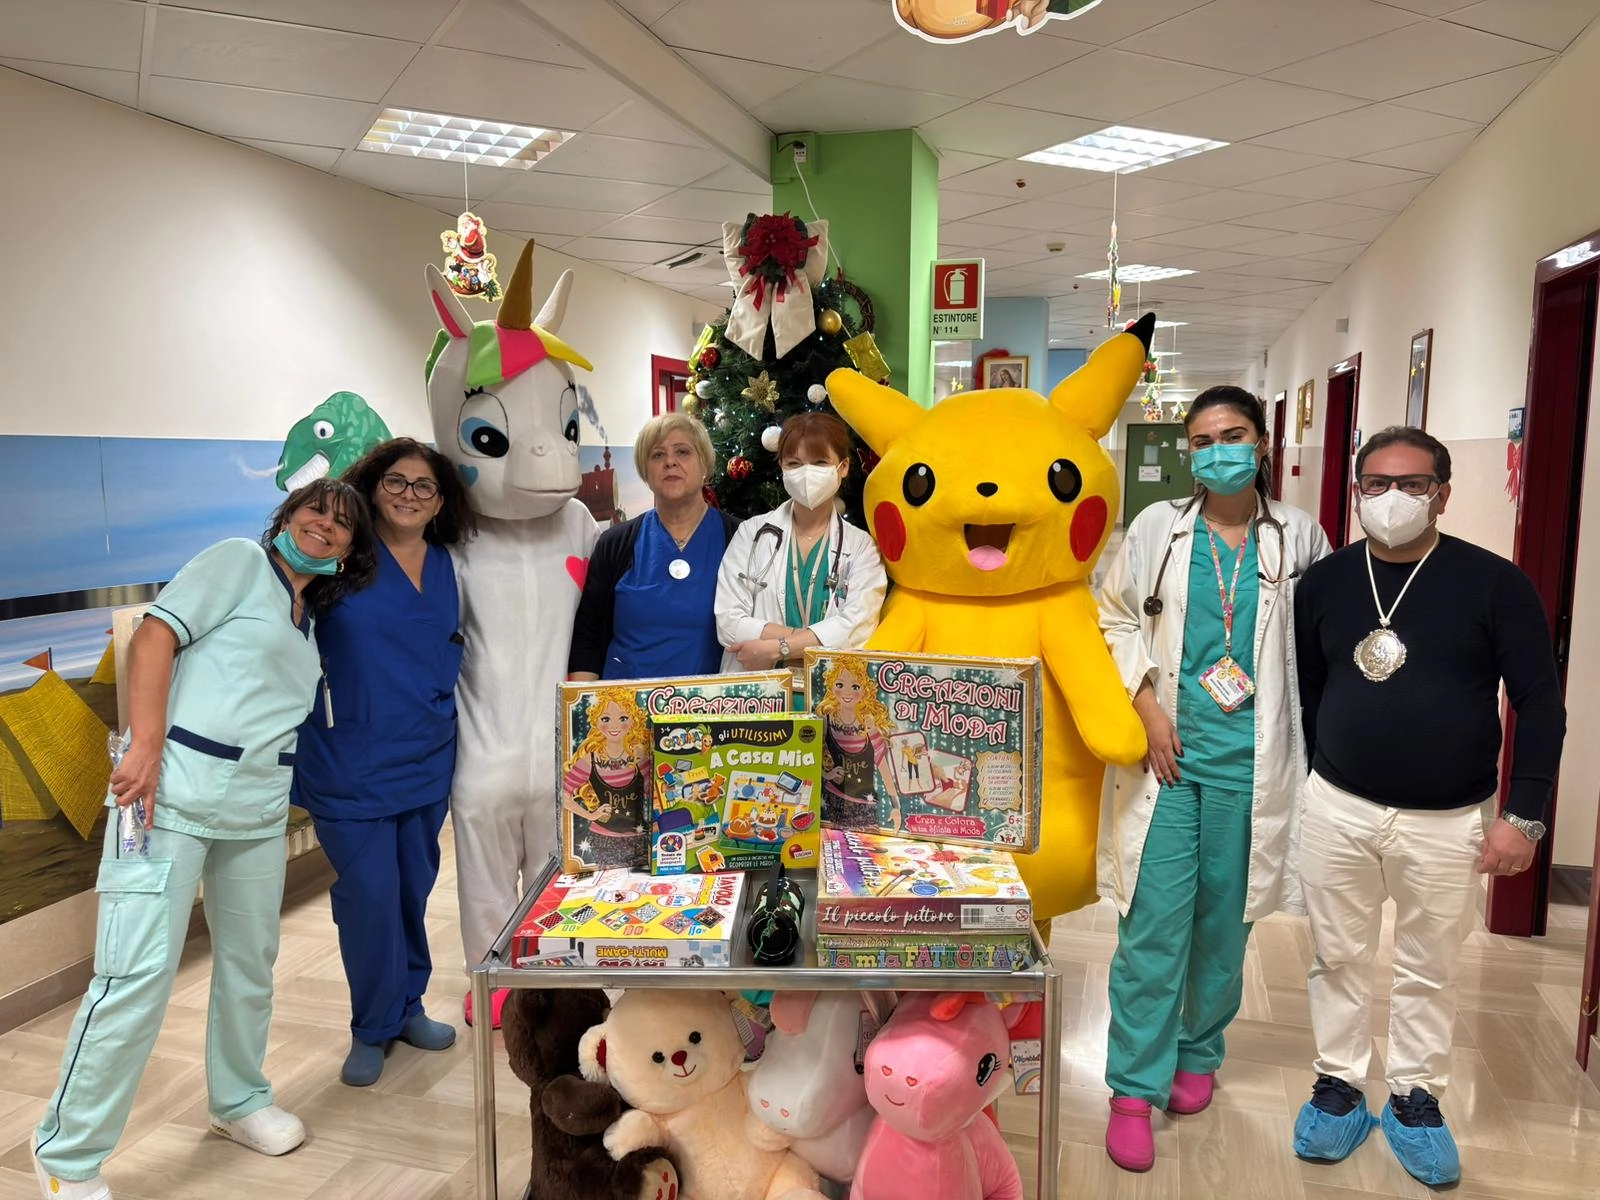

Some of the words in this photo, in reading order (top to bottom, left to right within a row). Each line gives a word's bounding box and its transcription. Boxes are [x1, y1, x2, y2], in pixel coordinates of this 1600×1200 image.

[933, 313, 978, 323] ESTINTORE
[944, 326, 959, 334] 114
[896, 701, 918, 721] DI
[719, 730, 730, 741] gli
[731, 728, 788, 742] UTILISSIMI
[710, 751, 724, 769] A
[727, 749, 774, 765] Casa
[778, 749, 815, 767] Mia
[838, 754, 868, 775] Love
[604, 790, 638, 809] Love
[914, 815, 935, 825] Crea
[944, 816, 976, 826] Colora
[960, 827, 981, 835] Moda
[822, 905, 841, 922] Il
[844, 905, 900, 928] piccolo
[904, 905, 956, 928] pittore
[597, 944, 669, 959] MULTI-GAME
[829, 950, 852, 968] la
[856, 949, 901, 968] mia
[905, 943, 1011, 968] FATTORIA
